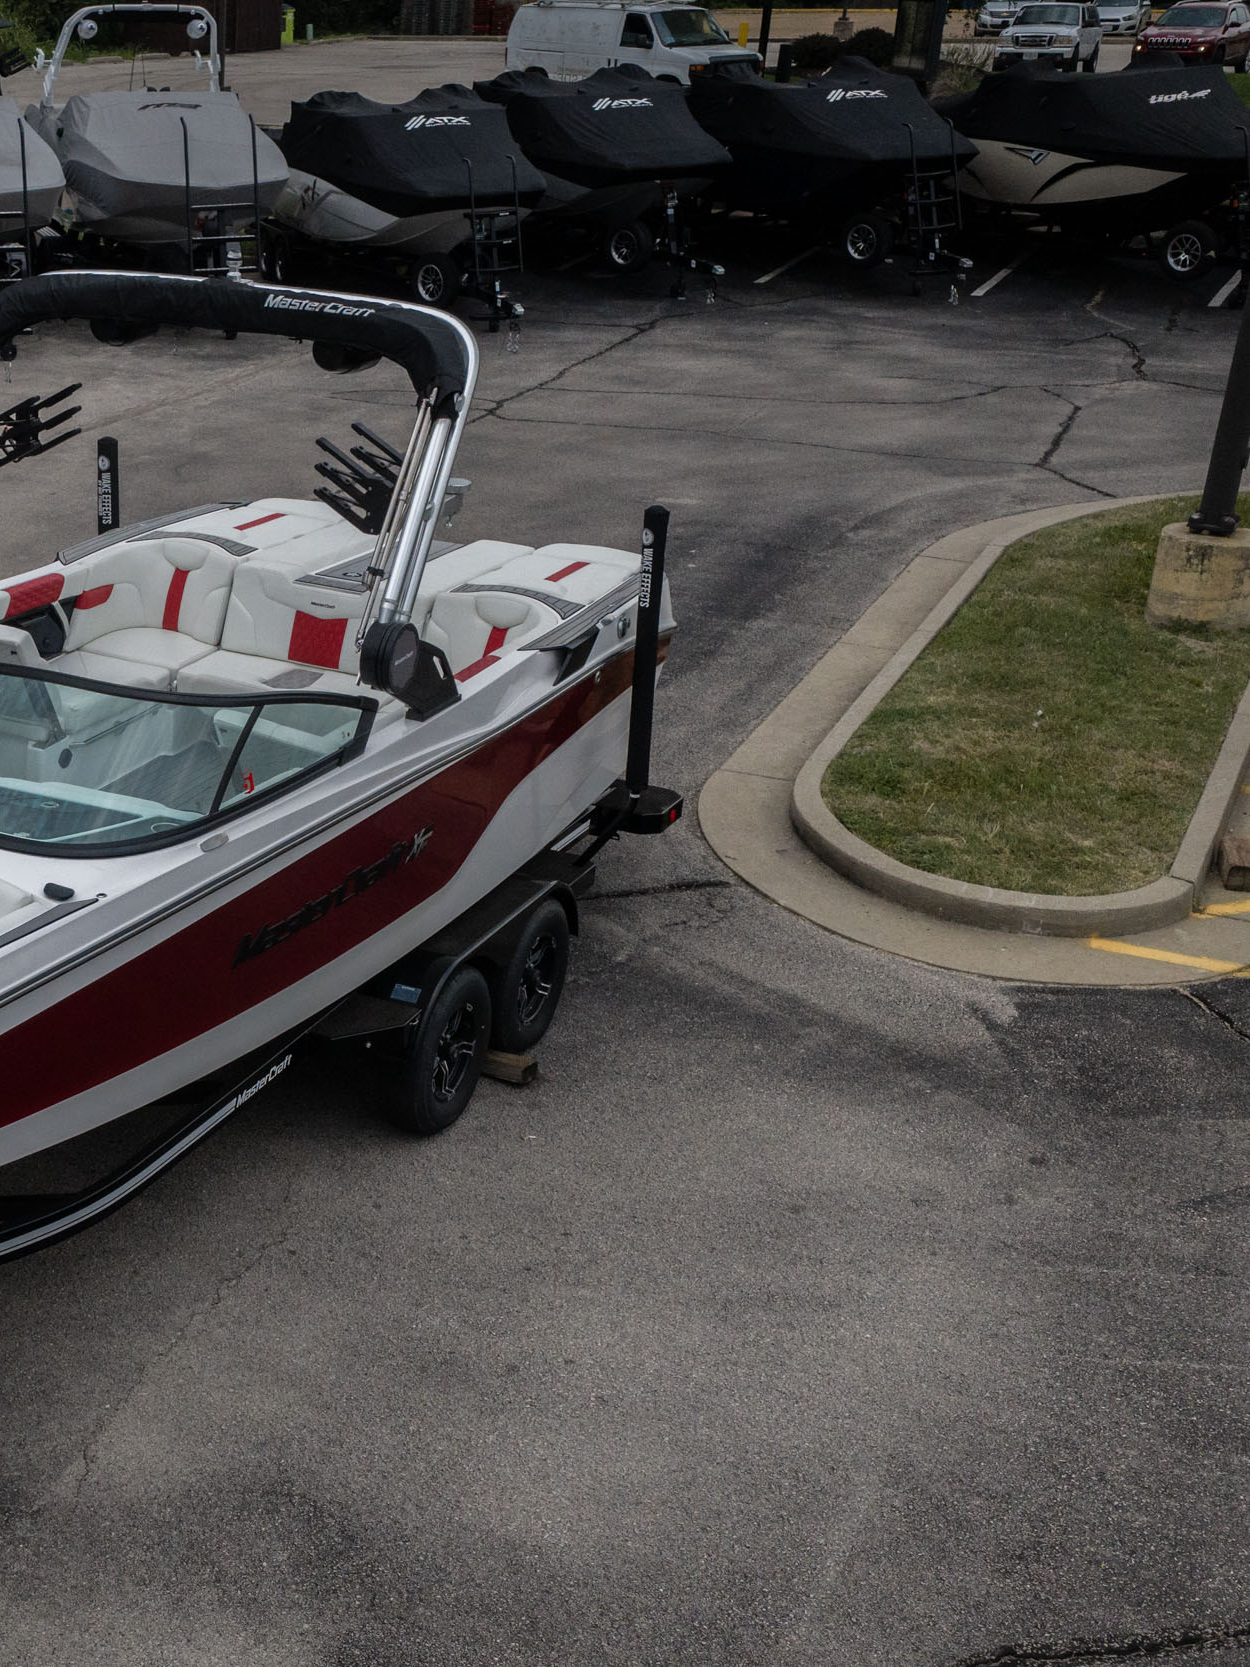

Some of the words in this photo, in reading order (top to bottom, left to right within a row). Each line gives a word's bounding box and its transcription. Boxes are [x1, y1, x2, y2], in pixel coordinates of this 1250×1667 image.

[264, 293, 376, 317] MasterCraft
[101, 472, 112, 495] WAKE
[101, 494, 112, 525] EFFECTS
[642, 548, 654, 573] WAKE
[639, 572, 652, 608] EFFECTS
[236, 1054, 293, 1108] MasterCraft
